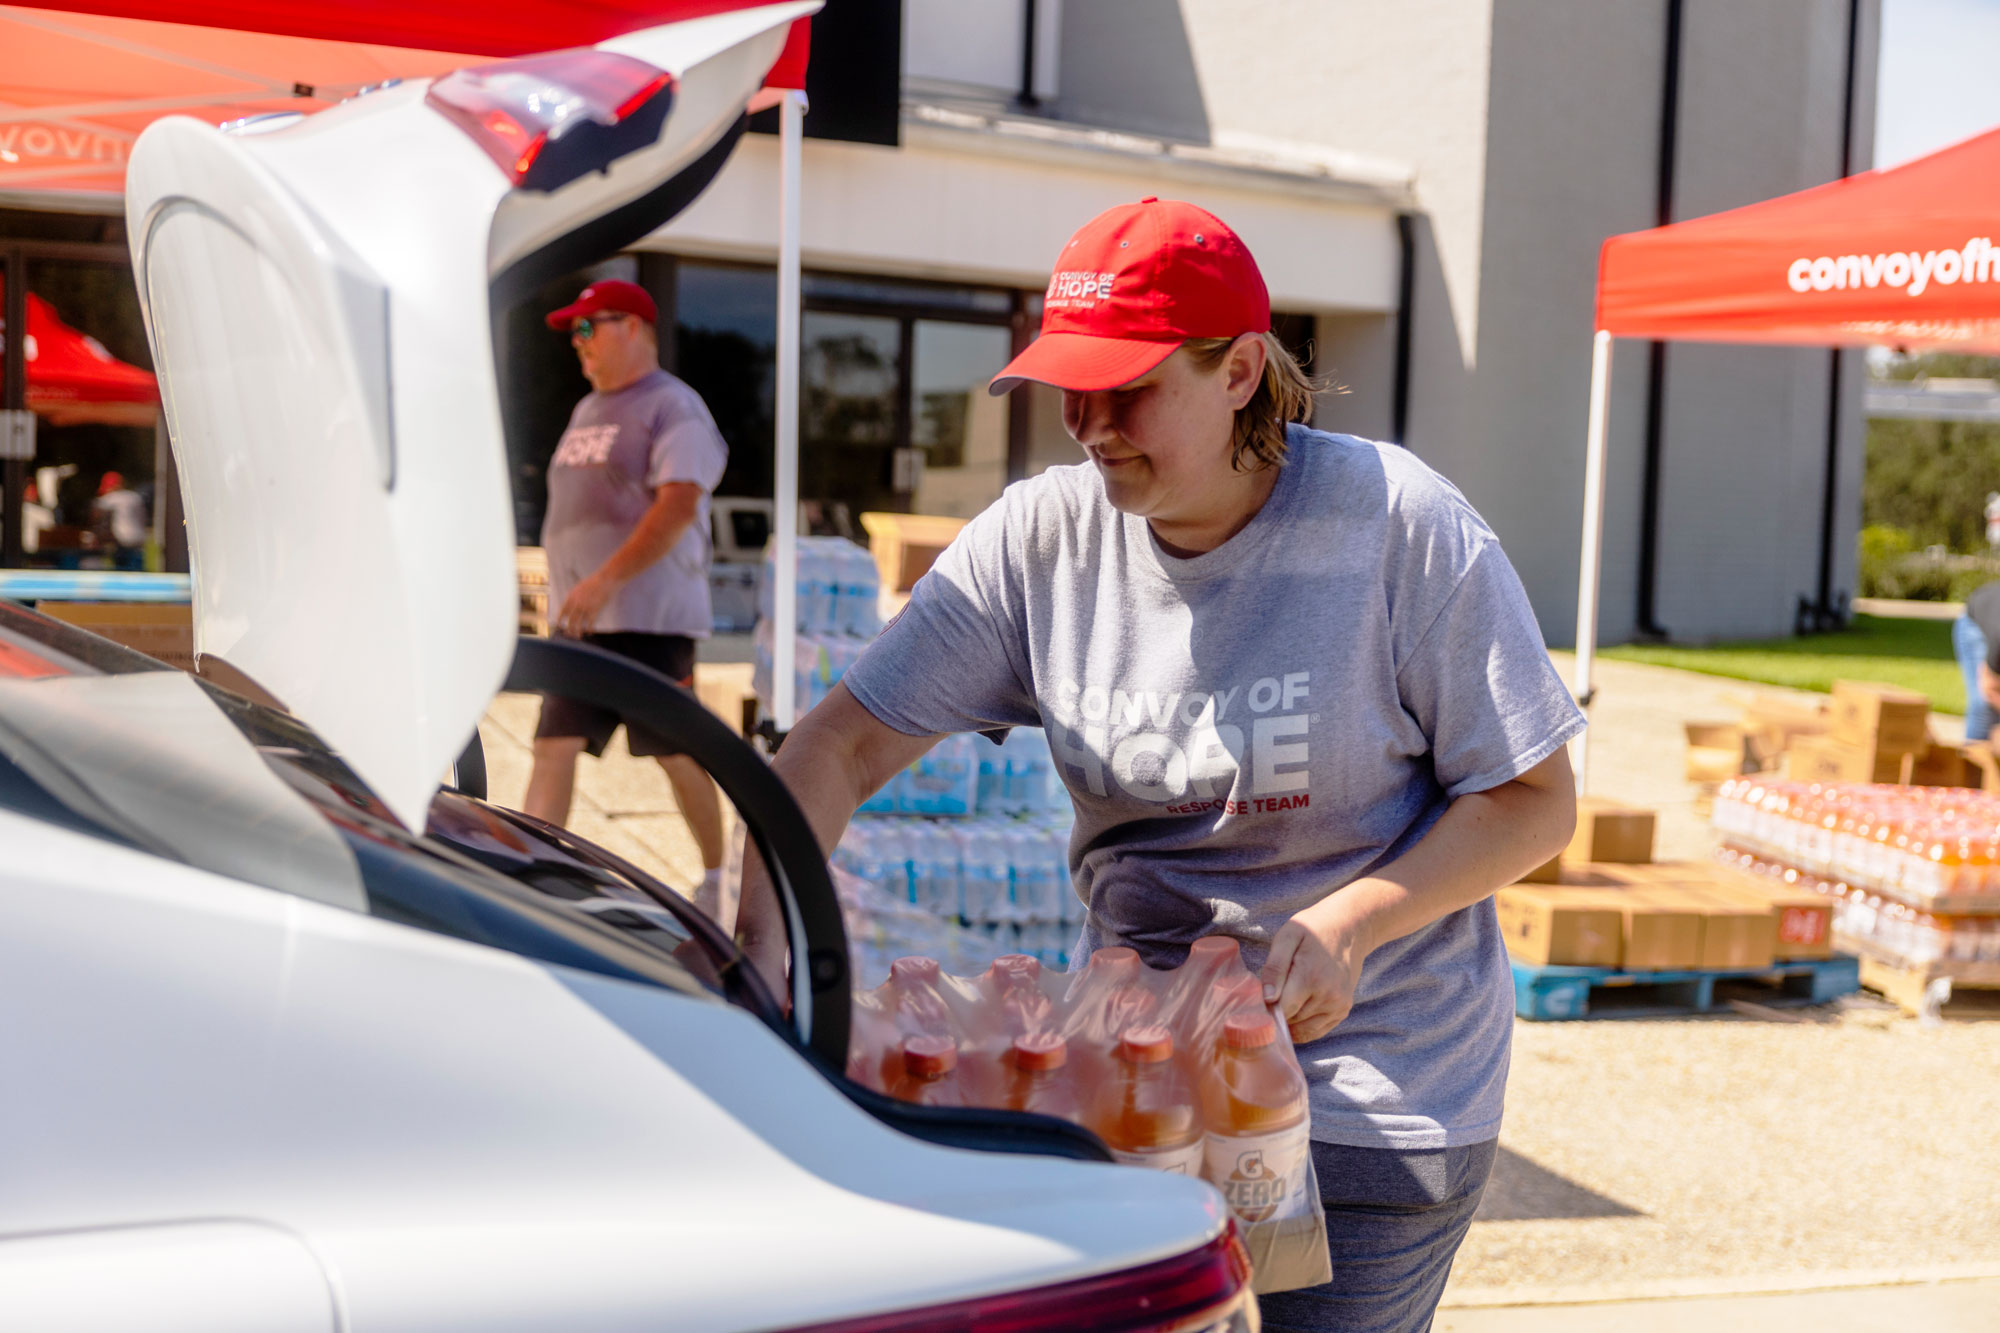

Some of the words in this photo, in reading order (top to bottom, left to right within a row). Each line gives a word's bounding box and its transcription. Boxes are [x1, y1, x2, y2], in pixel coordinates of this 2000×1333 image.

[1060, 272, 1098, 281] CONVOY
[1099, 273, 1115, 282] OF
[1056, 281, 1112, 299] HOPE
[1056, 677, 1240, 728] CONVOY
[1248, 671, 1310, 713] OF
[1051, 714, 1310, 802] HOPE
[1253, 794, 1310, 813] TEAM
[1224, 1177, 1287, 1206] ZERO
